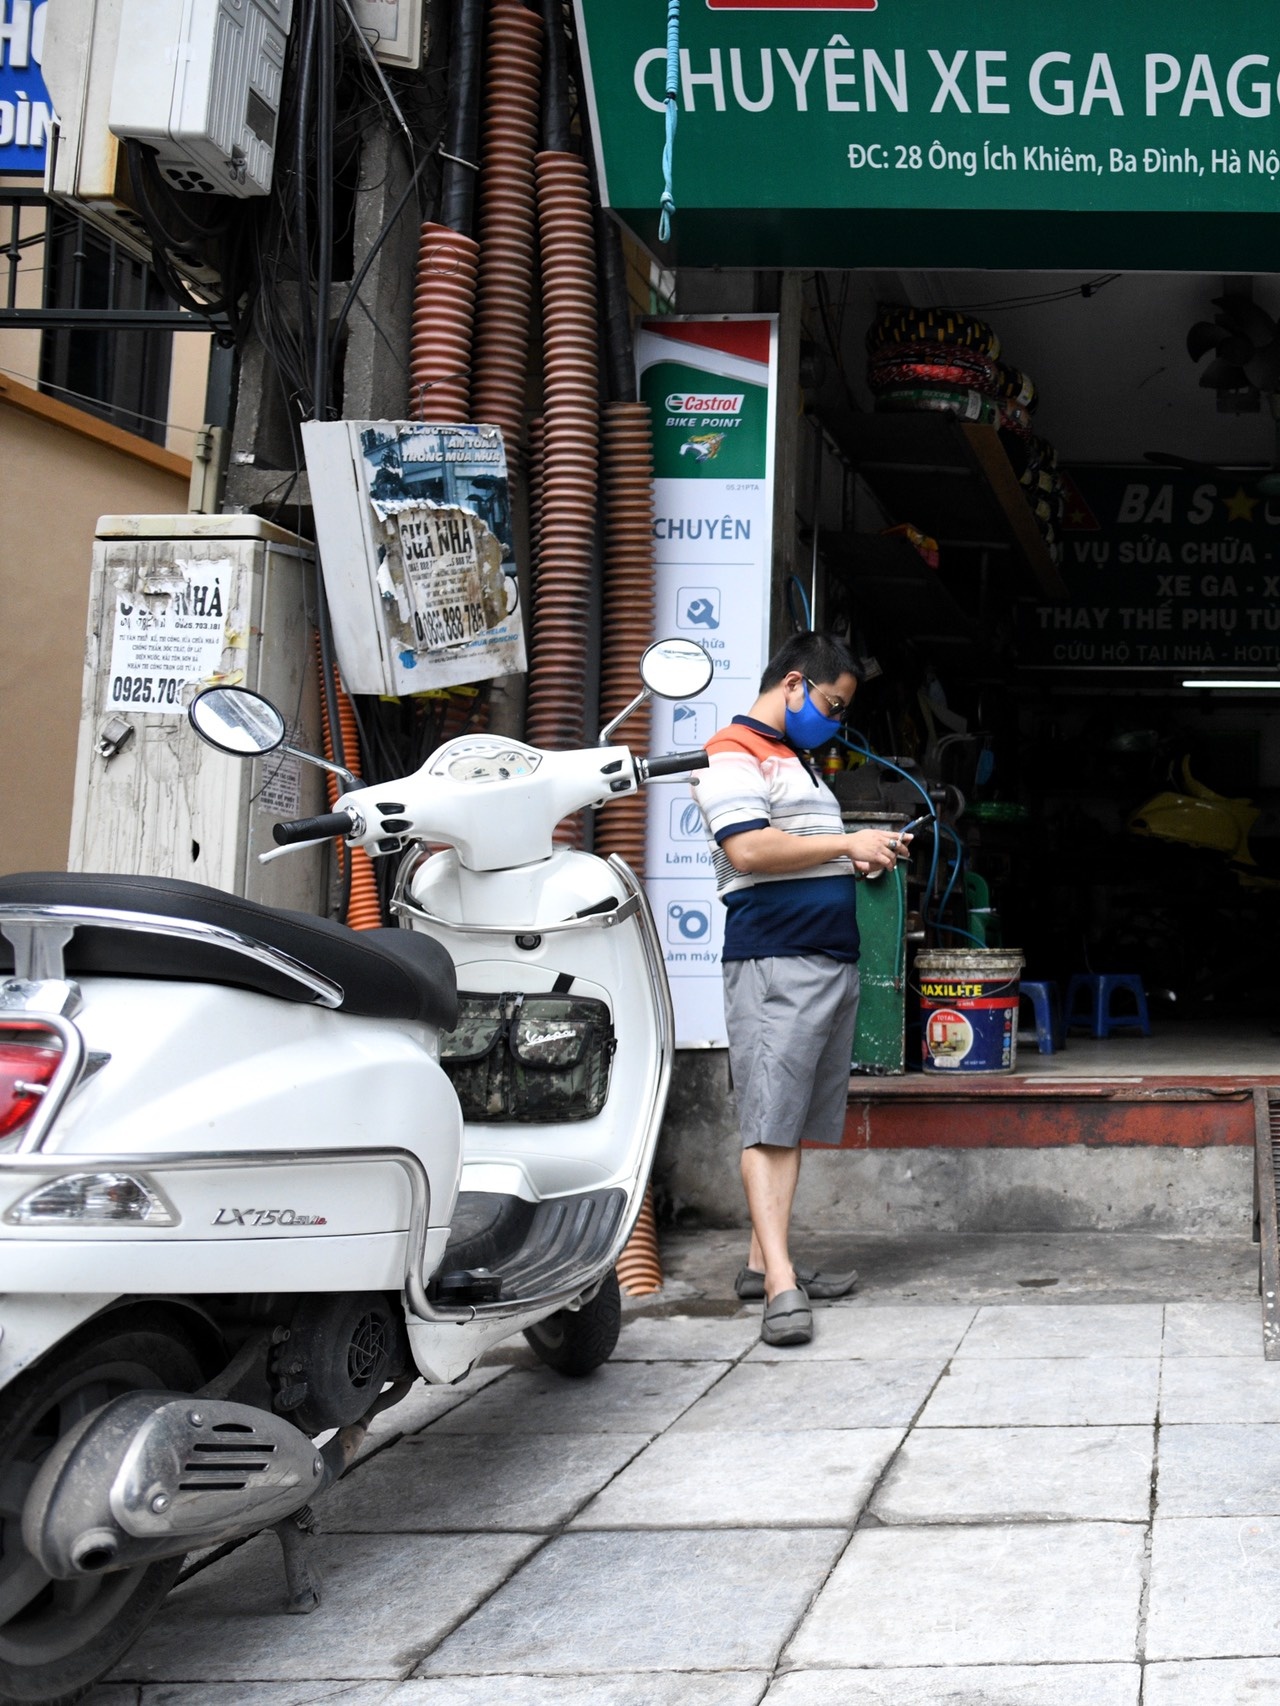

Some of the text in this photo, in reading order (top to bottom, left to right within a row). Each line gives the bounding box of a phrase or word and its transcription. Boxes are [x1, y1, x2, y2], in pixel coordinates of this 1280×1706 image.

[634, 34, 905, 112] CHUYÊN
[928, 50, 1009, 113] XE
[1029, 52, 1124, 115] GA
[848, 144, 888, 168] ĐC:
[895, 146, 922, 169] 28
[929, 140, 976, 176] Ông
[984, 141, 1016, 170] Ích
[1024, 146, 1102, 175] Khiêm,
[1110, 149, 1136, 172] Ba
[1143, 148, 1204, 176] Đình,
[1212, 149, 1240, 173] Hà
[685, 396, 738, 411] Castrol
[665, 418, 742, 427] BIKE POINT
[1117, 484, 1174, 523] BA
[652, 515, 750, 540] CHUYÊN
[1119, 533, 1174, 564] SỬA
[1181, 535, 1257, 564] CHỮA
[1156, 575, 1192, 597] XE
[1201, 575, 1239, 598] GA
[1036, 607, 1111, 630] THAY
[1119, 599, 1174, 630] THẾ
[1182, 607, 1237, 637] PHỤ
[1174, 641, 1216, 661] NHÀ
[665, 852, 692, 864] Làm
[664, 950, 718, 963] àm máy
[920, 983, 983, 997] MAXILITE
